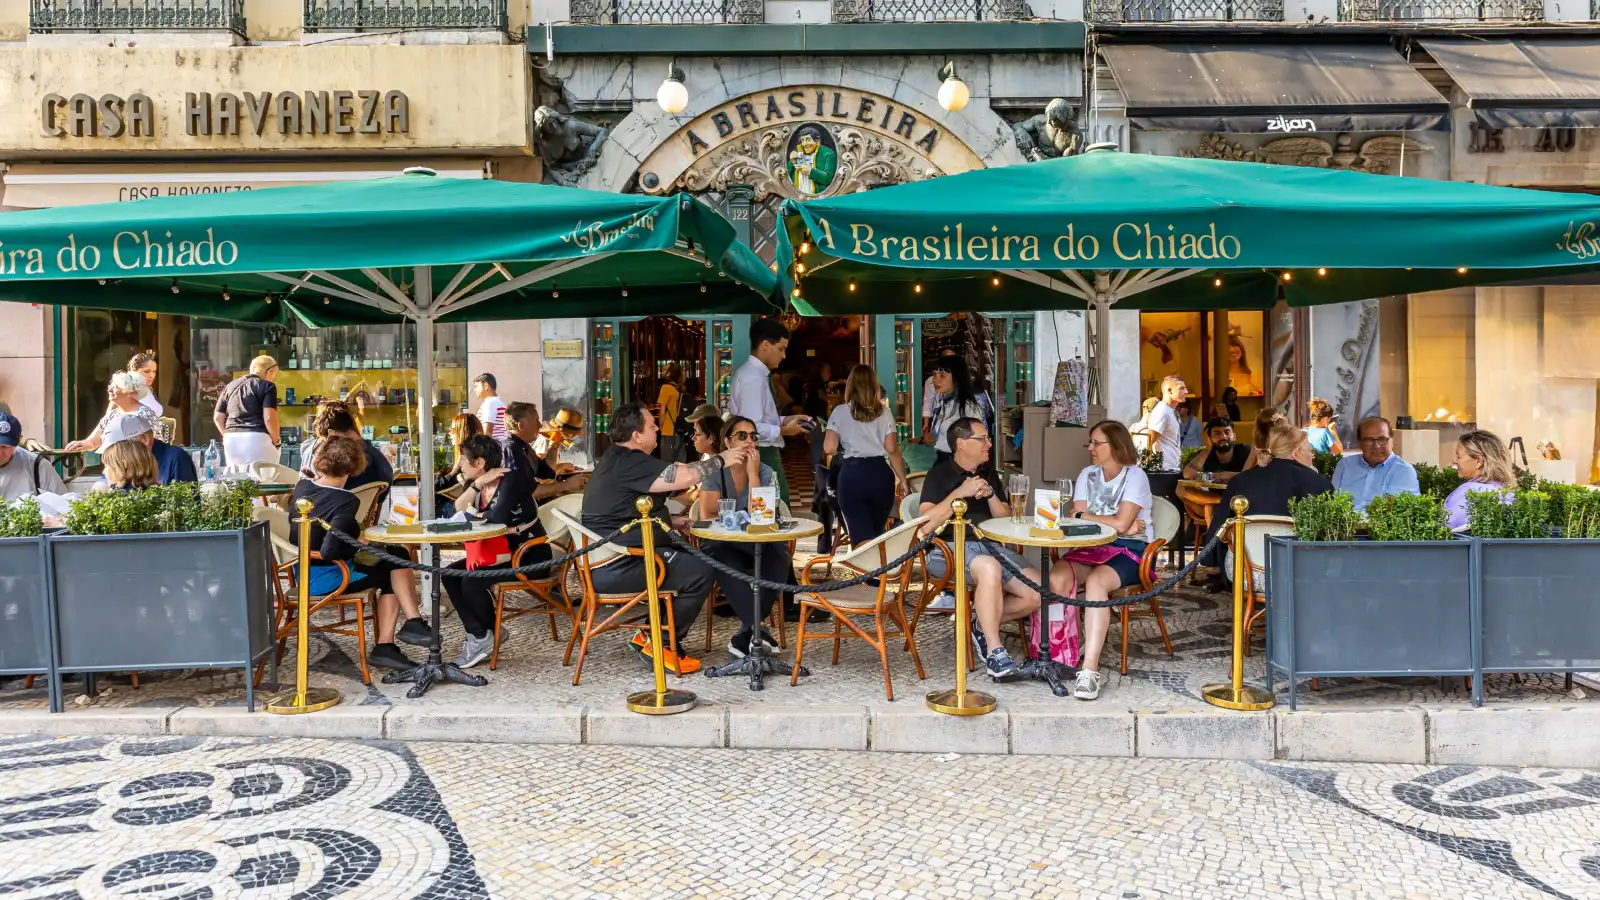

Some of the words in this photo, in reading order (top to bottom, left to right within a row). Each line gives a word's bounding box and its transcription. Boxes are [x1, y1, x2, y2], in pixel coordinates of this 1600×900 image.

[41, 92, 154, 138] CASA
[185, 89, 409, 138] HAVANEZA
[686, 129, 709, 155] A
[711, 91, 939, 154] BRASILEIRA
[732, 209, 748, 221] 122
[56, 233, 101, 272] do
[113, 227, 239, 270] Chiado
[850, 222, 1041, 262] Brasileira
[1053, 222, 1100, 261] do
[1112, 222, 1242, 262] Chiado
